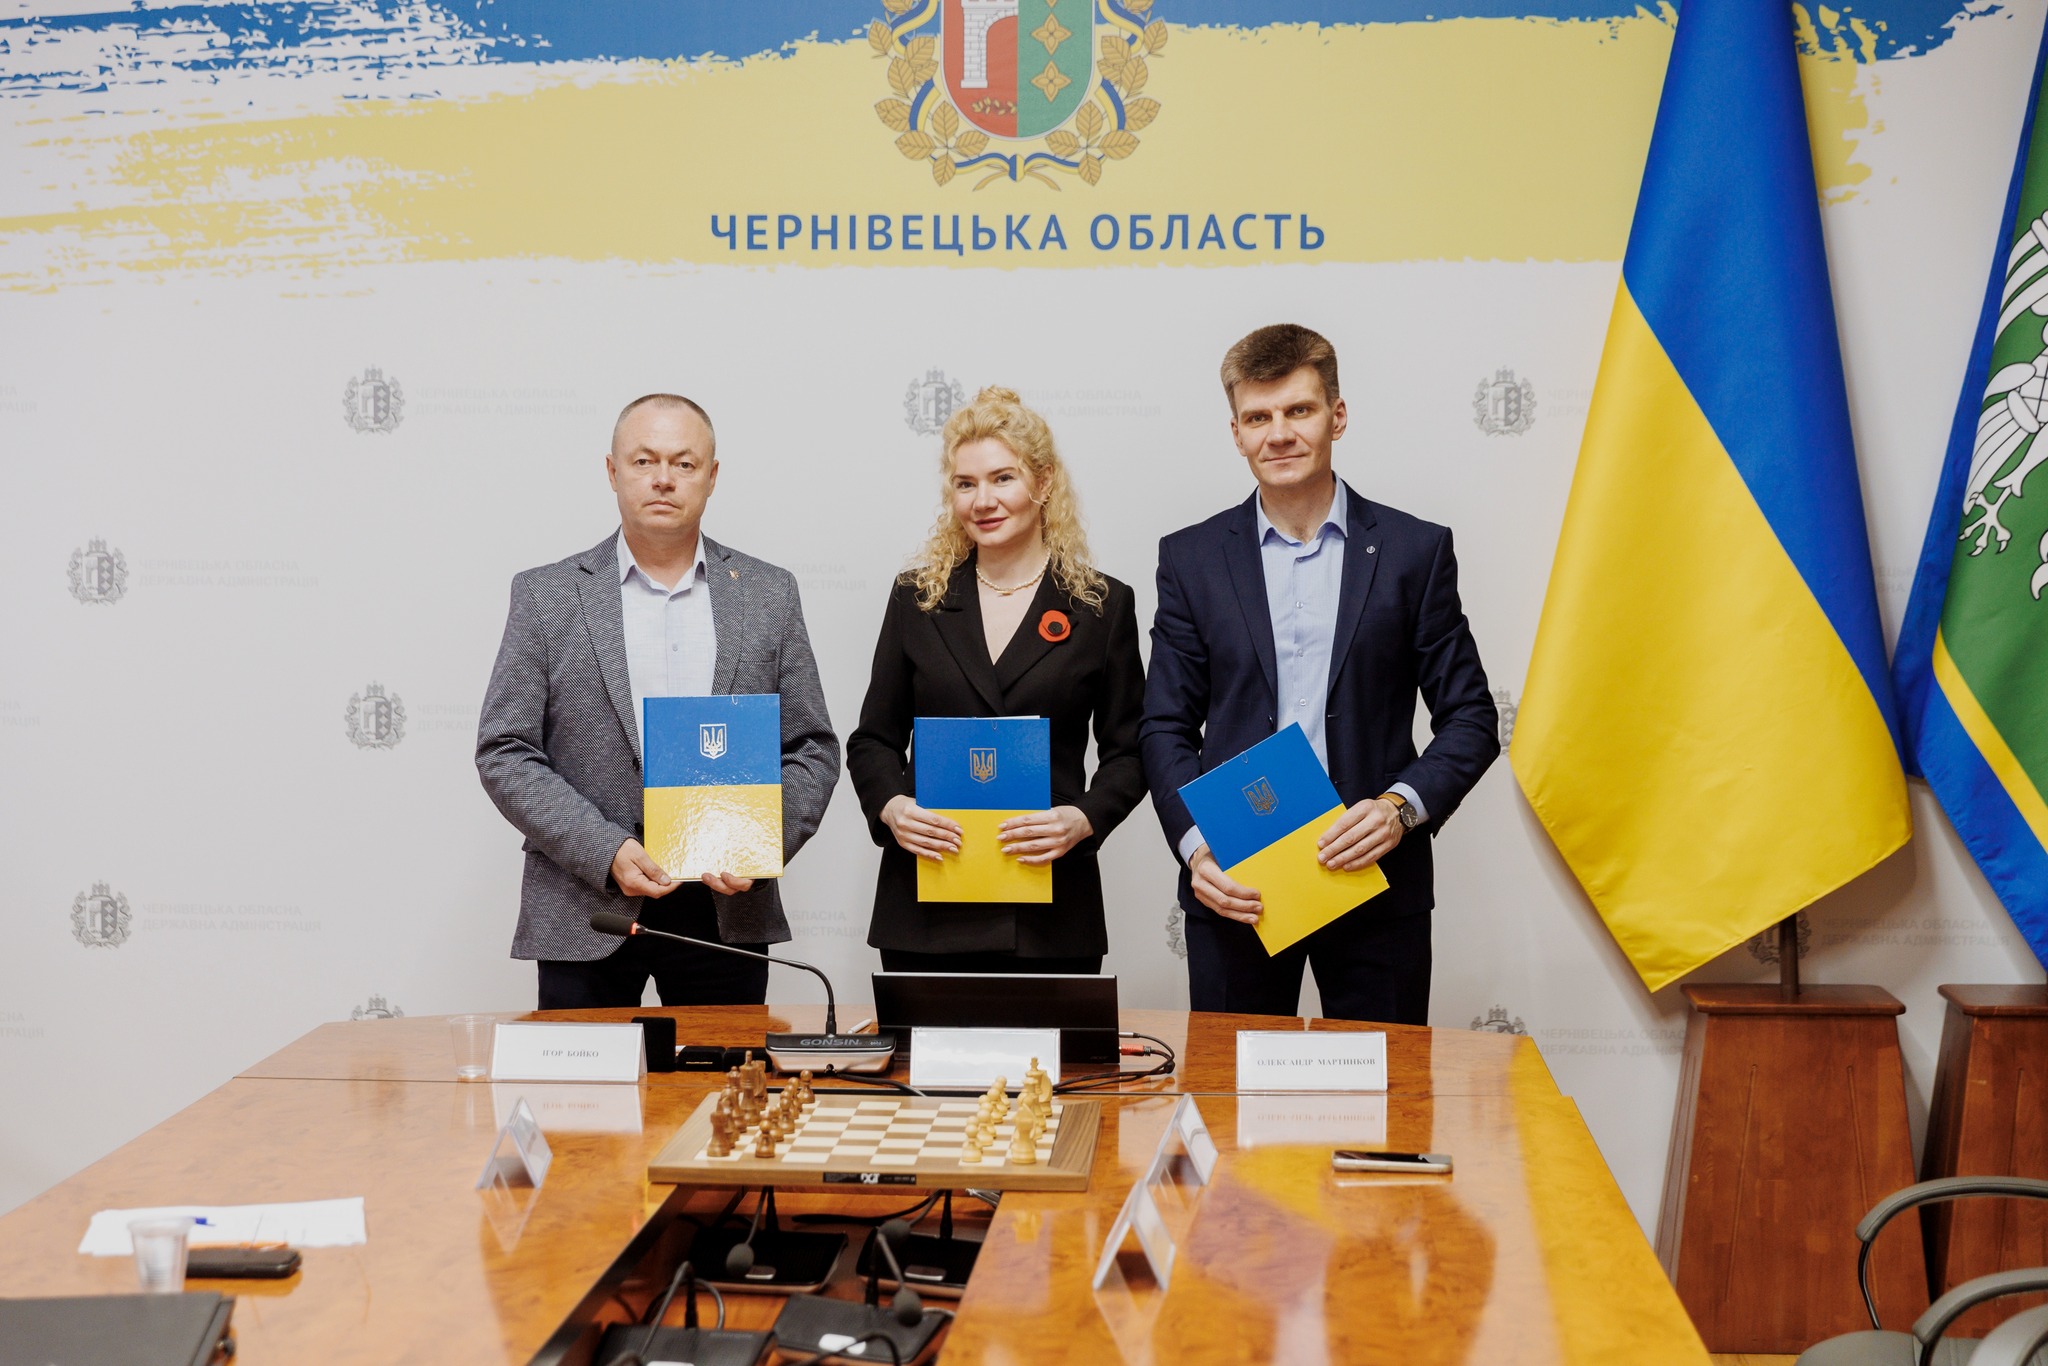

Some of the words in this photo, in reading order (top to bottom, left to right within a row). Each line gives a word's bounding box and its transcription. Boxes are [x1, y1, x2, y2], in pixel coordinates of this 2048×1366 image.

[710, 214, 1068, 256] ЧЕРНІВЕЦЬКА
[1089, 213, 1326, 251] ОБЛАСТЬ
[800, 1038, 860, 1046] GONSIN
